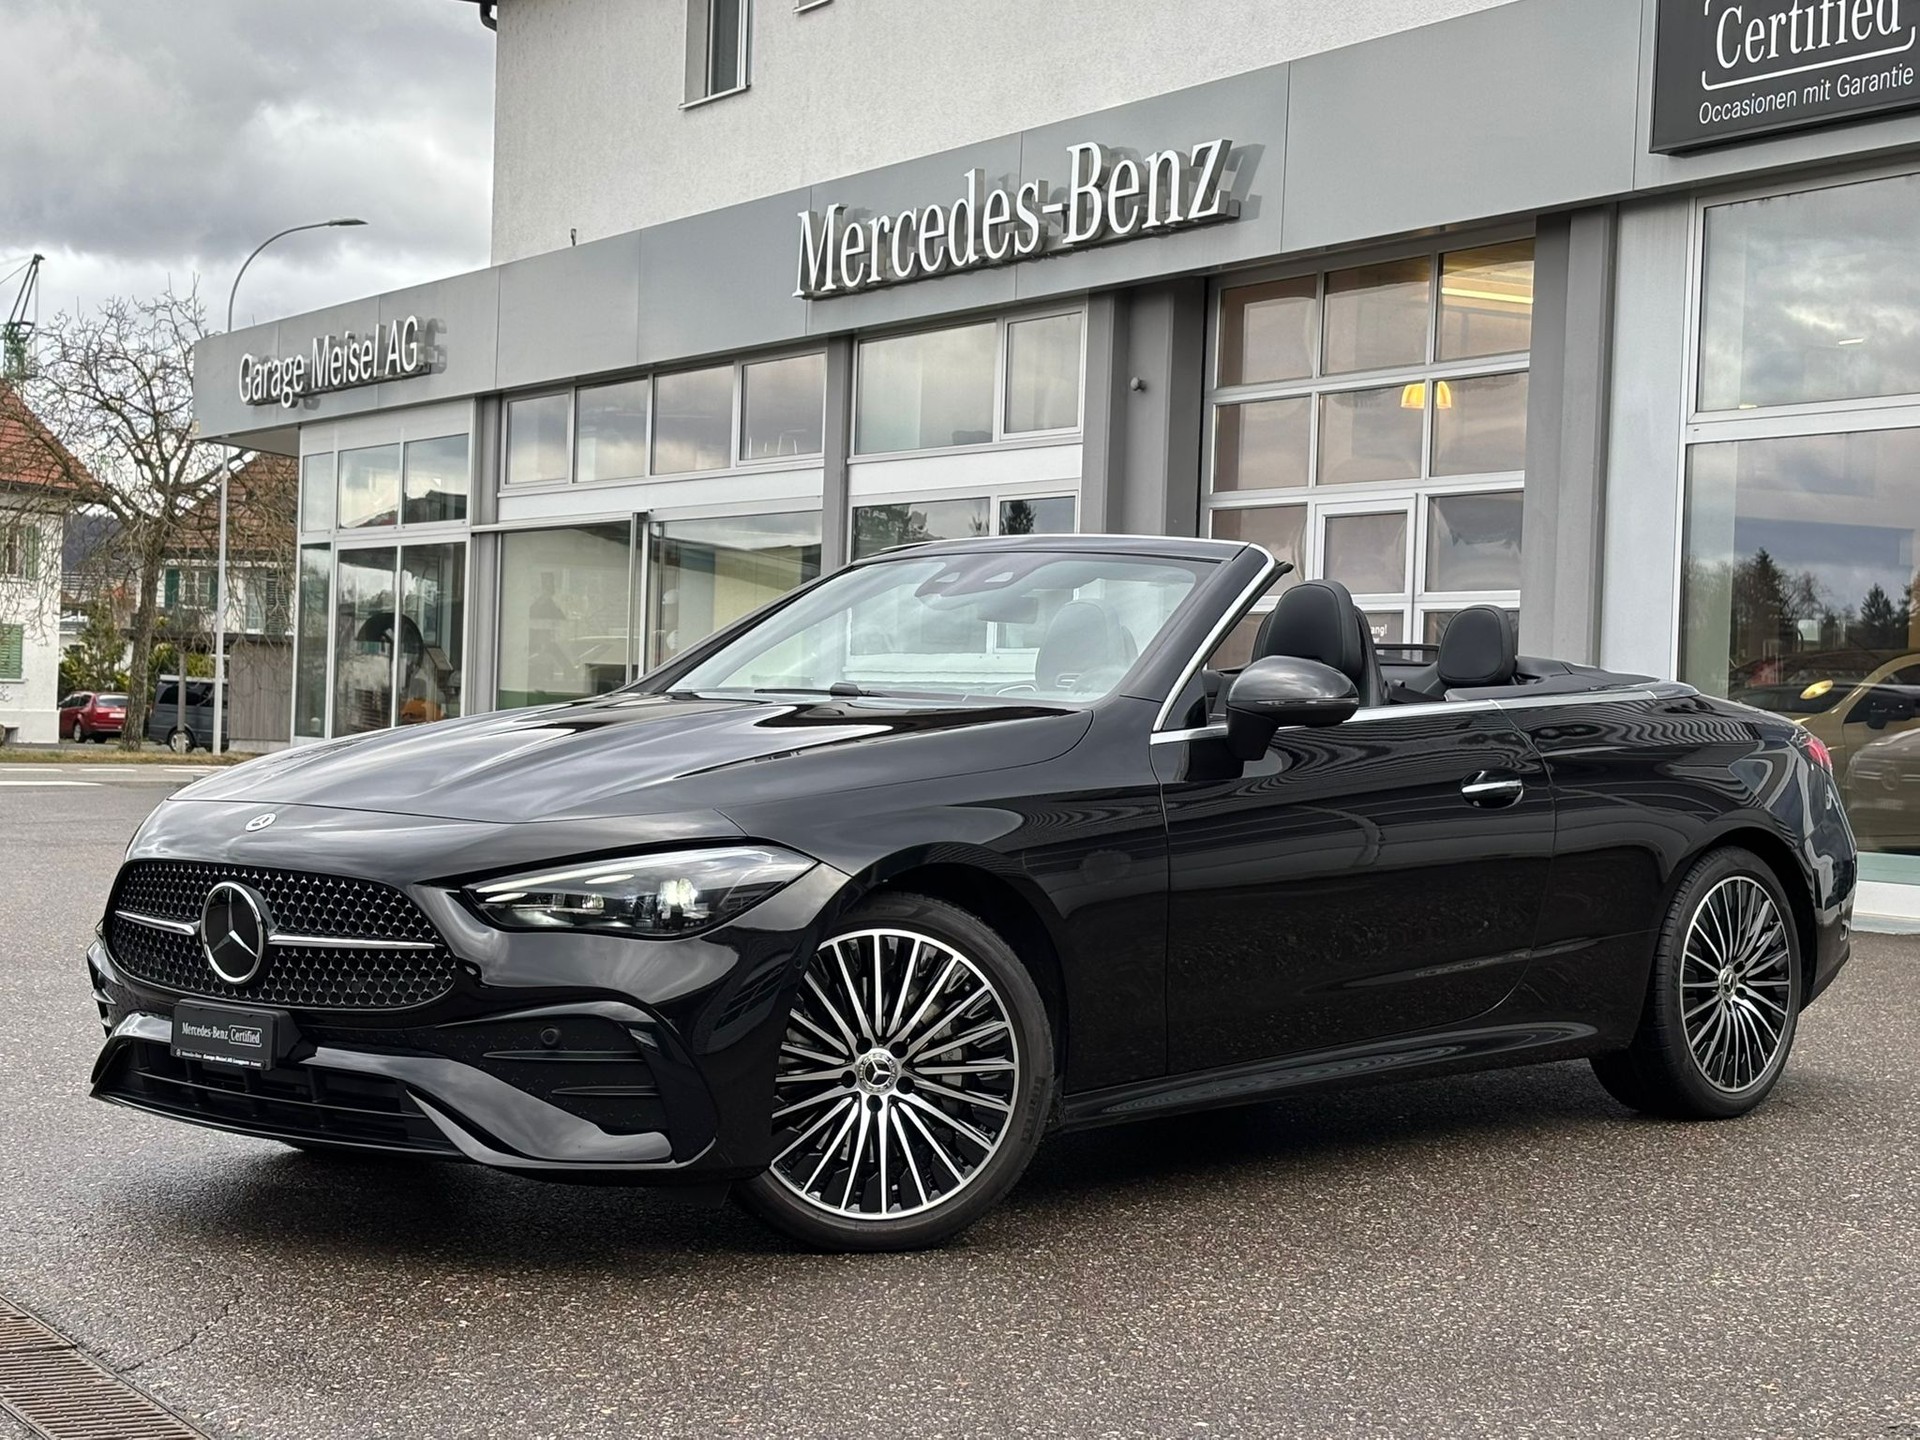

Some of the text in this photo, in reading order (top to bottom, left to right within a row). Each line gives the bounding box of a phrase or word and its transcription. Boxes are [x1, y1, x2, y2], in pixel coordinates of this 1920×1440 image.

[1699, 63, 1914, 124] Occasionen mit Garantie
[792, 138, 1228, 298] Mercedes-Benz
[239, 315, 419, 408] Garage Meisel AG
[181, 1021, 260, 1044] Mercedes-Benz Certified
